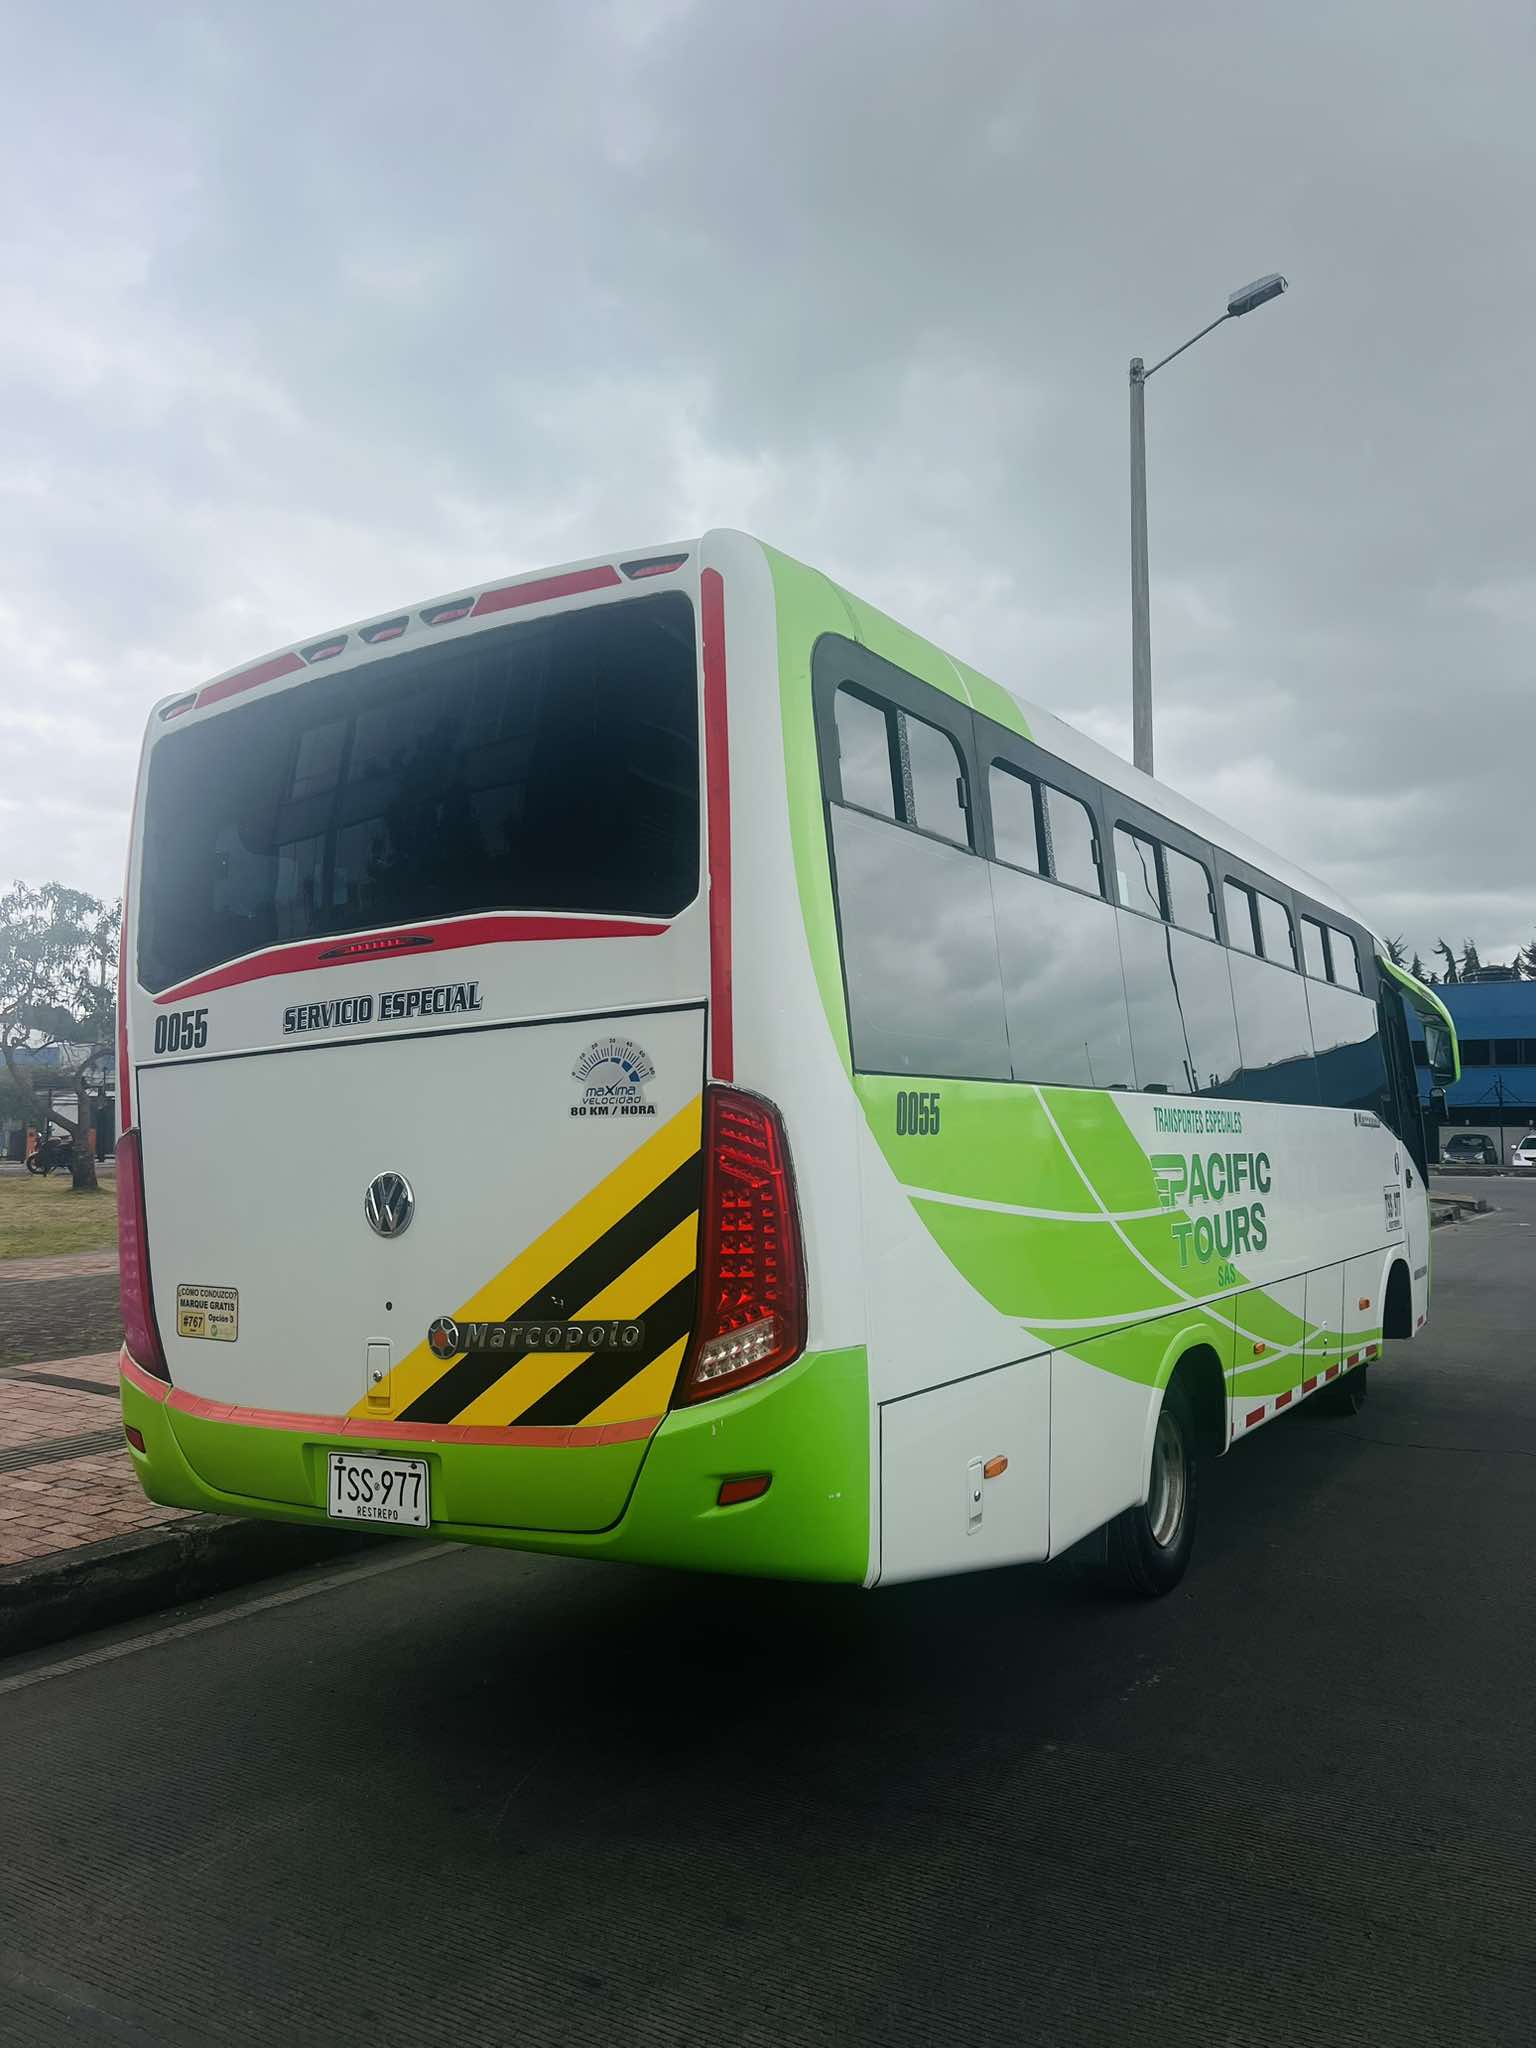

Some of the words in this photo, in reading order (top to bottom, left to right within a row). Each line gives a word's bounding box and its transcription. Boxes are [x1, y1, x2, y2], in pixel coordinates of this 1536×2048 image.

[283, 996, 372, 1035] SERVICIO
[378, 981, 484, 1022] ESPECIAL
[153, 1009, 209, 1055] 0055
[570, 1106, 587, 1116] 80
[589, 1106, 609, 1116] KM
[620, 1105, 656, 1115] HORA
[896, 1091, 941, 1136] 0055
[1153, 1107, 1204, 1134] TRANSPORTES
[1205, 1110, 1243, 1134] ESPECIALES
[1150, 1151, 1272, 1209] PACIFIC
[1171, 1201, 1268, 1269] TOURS
[1217, 1263, 1236, 1287] SAS
[180, 1299, 209, 1310] MARQUE
[209, 1301, 235, 1312] GRATIS
[183, 1314, 204, 1328] #767
[464, 1321, 640, 1350] Marcopolo
[333, 1465, 374, 1503] TSS
[381, 1470, 422, 1509] 977
[356, 1505, 399, 1521] RESTREPO
